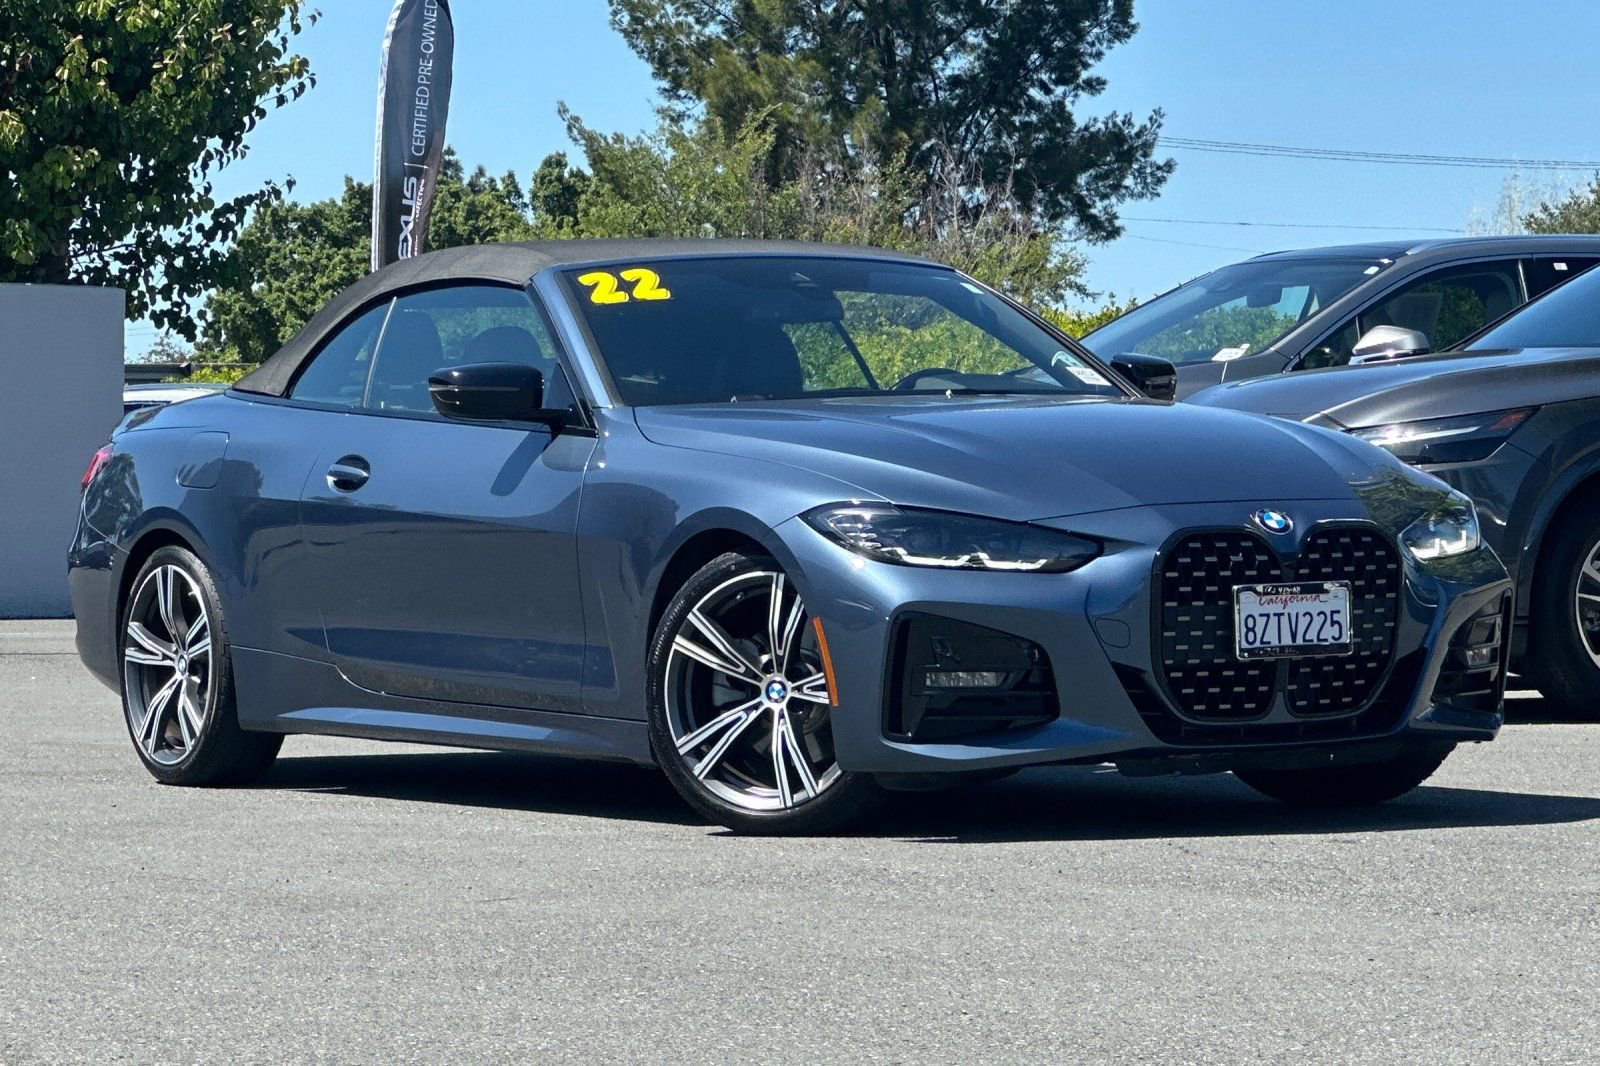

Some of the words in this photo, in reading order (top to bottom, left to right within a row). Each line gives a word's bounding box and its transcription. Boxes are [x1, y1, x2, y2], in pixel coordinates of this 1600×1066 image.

[417, 0, 438, 85] PRE-OWNED
[411, 86, 430, 157] CERTIFIED
[398, 176, 417, 260] EXUS
[578, 268, 671, 304] 22
[1244, 610, 1343, 645] 8ZTV225
